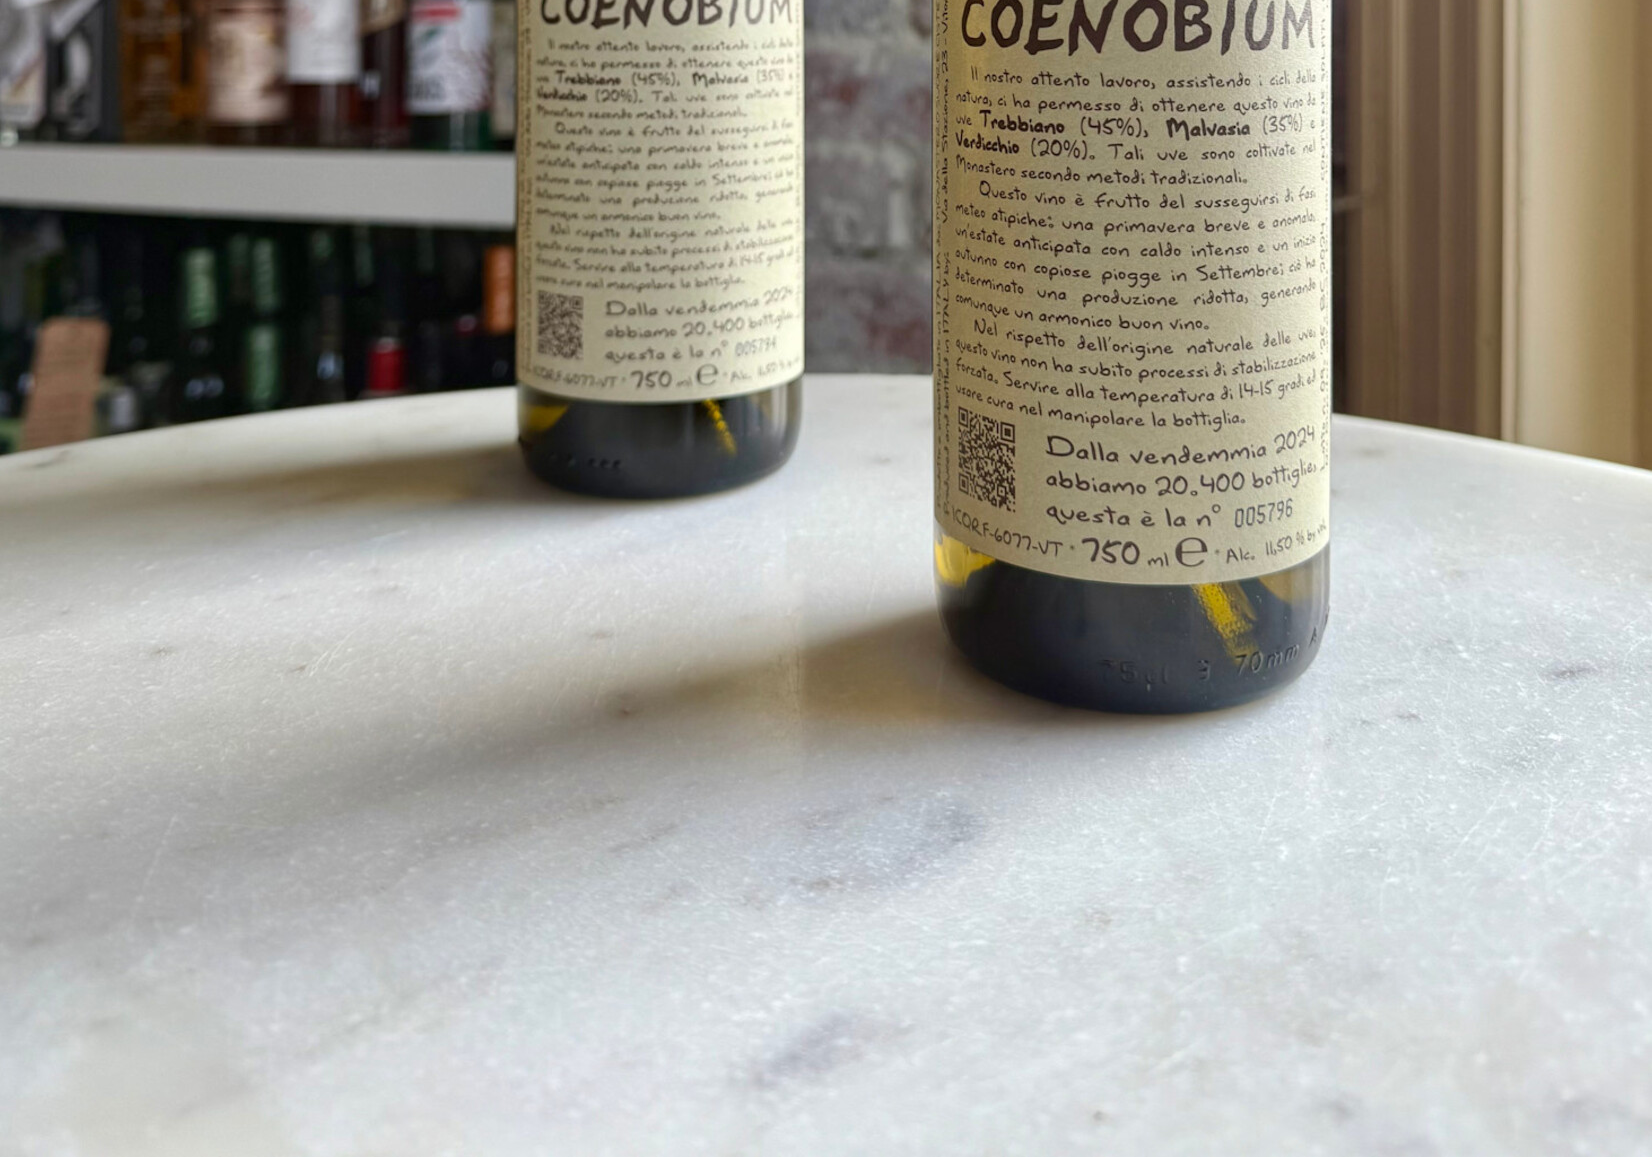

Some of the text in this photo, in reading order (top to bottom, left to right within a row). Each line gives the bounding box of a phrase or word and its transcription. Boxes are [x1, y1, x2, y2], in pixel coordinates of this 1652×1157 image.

[971, 65, 978, 81] Il
[984, 69, 1023, 84] nostro
[1031, 71, 1089, 87] attento
[1101, 72, 1155, 89] lavoro,
[1166, 72, 1251, 88] assistendo
[1270, 70, 1290, 86] cicli
[956, 92, 1303, 115] natura, ci ha permesso di ottenere questo vino
[956, 110, 1302, 140] uve Trebbiano (45%), Malvasia (35%)
[955, 129, 1019, 154] Verdicchio
[1031, 138, 1095, 160] (20%).
[1108, 143, 1143, 160] Tali
[1157, 149, 1188, 161] uve
[1201, 148, 1235, 160] sono
[1246, 143, 1296, 159] coltivate
[956, 154, 1247, 184] Monastero secondo metodi tradizionali.
[979, 180, 1027, 200] Questo
[1035, 193, 1065, 205] vino
[1075, 194, 1085, 206] è
[1095, 192, 1149, 209] frutto
[1160, 194, 1184, 209] del
[1194, 195, 1279, 213] susseguirsi
[1285, 188, 1294, 202] di
[956, 204, 985, 218] meteo
[1062, 221, 1093, 231] una
[1104, 221, 1194, 236] primavera
[1205, 219, 1250, 231] breve
[1014, 235, 1091, 256] anticipata
[1101, 246, 1130, 256] con
[1140, 243, 1181, 257] caldo
[1192, 242, 1249, 257] intenso
[1258, 245, 1265, 253] e
[1273, 241, 1288, 251] un
[955, 249, 998, 266] autunno
[1004, 260, 1026, 273] con
[1034, 265, 1092, 280] copiose
[1101, 269, 1161, 288] piogge
[1171, 271, 1187, 281] in
[955, 267, 1316, 307] determinato una produzione ridotta, generando
[605, 300, 760, 316] Dalla vendemmia
[955, 295, 1210, 331] comunque un armonico buon vino.
[605, 323, 677, 338] abbiamo
[974, 318, 998, 336] Nel
[1006, 329, 1065, 347] rispetto
[1077, 335, 1173, 361] dell'origine
[1186, 335, 1253, 355] naturale
[1263, 330, 1291, 347] delle
[605, 346, 666, 363] questa
[956, 338, 1316, 383] questo vino non ha subito processi di stabilizzazione
[630, 371, 672, 389] 750
[955, 357, 1304, 407] forzata. Servire alla temperatura di 14-15 gradi
[955, 384, 1246, 432] usare cura nel manipolare la bottiglia.
[1046, 426, 1315, 465] Dalla vendemmia 2024
[1046, 470, 1146, 494] abbiamo
[1155, 471, 1245, 496] 20.400
[1046, 505, 1130, 525] questa
[1141, 511, 1155, 527] è
[1165, 508, 1186, 527] la
[1234, 498, 1293, 528] 005796
[1082, 538, 1140, 564] 750
[1148, 553, 1169, 566] ml
[1226, 547, 1256, 564] Alc.
